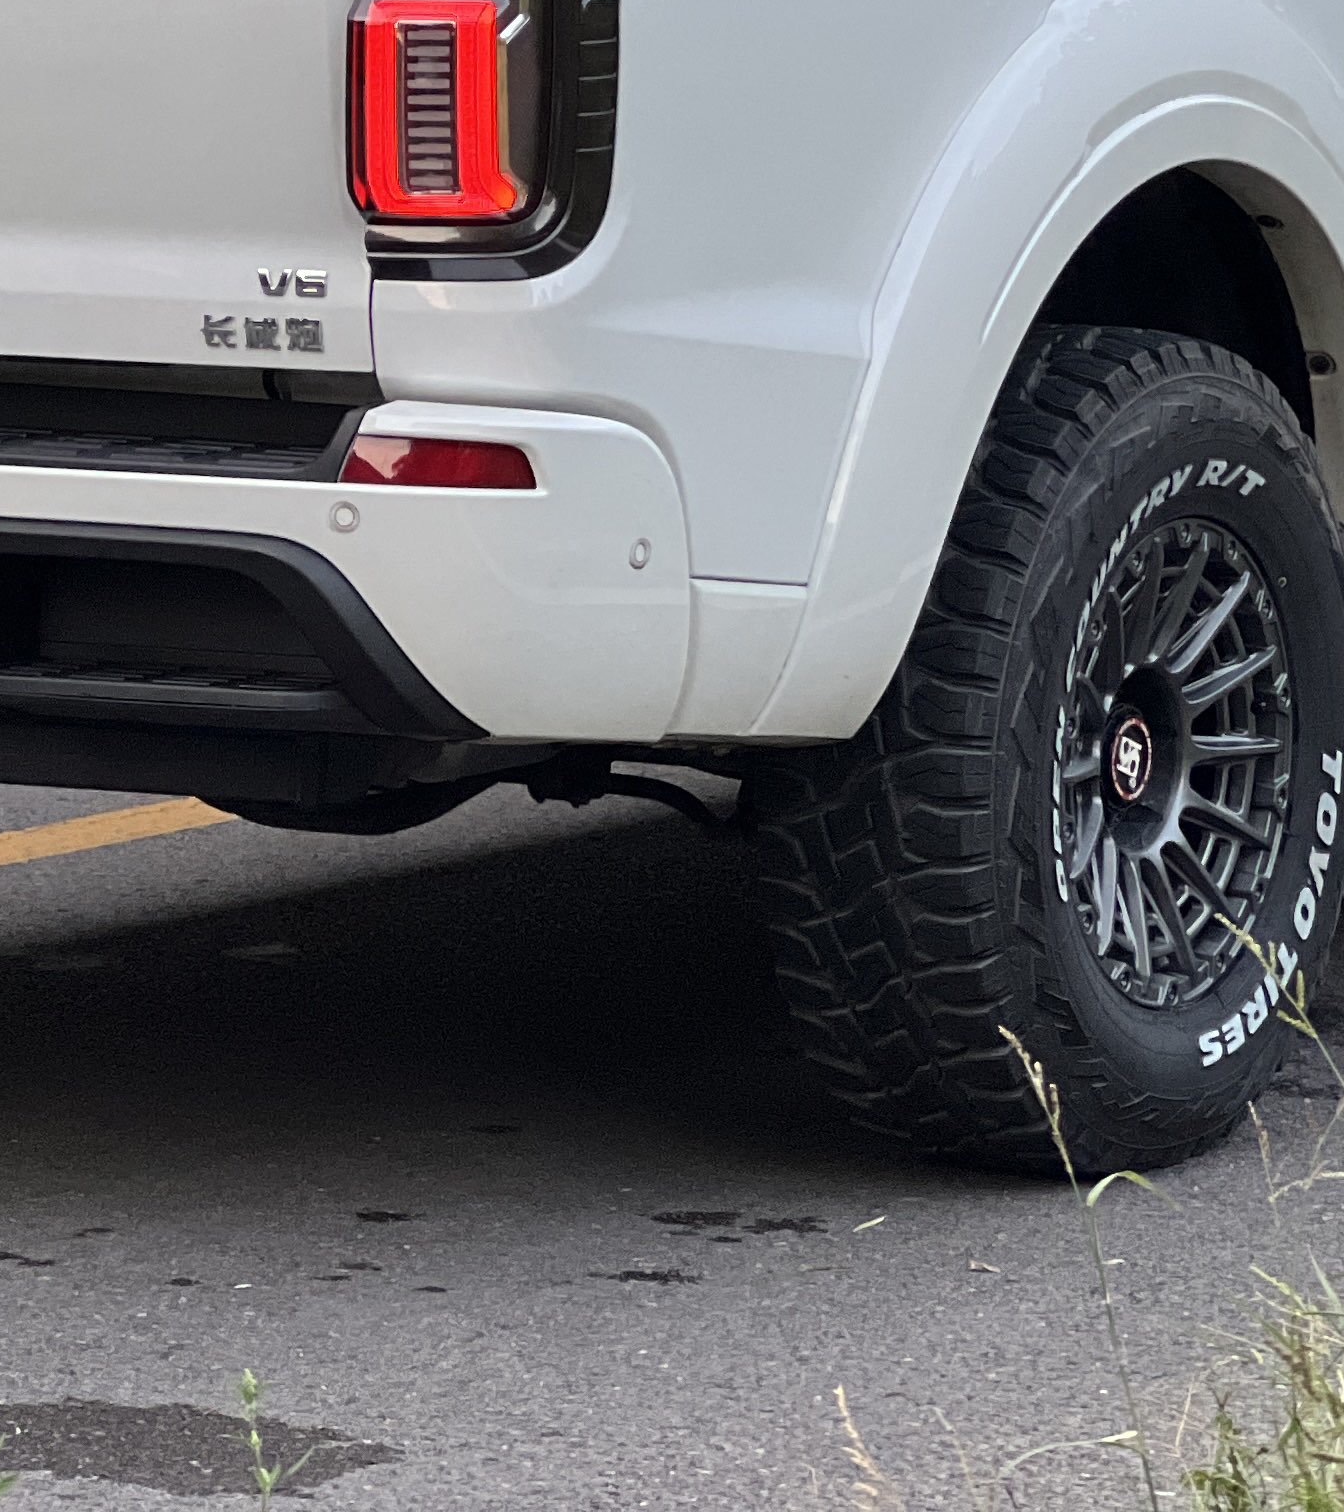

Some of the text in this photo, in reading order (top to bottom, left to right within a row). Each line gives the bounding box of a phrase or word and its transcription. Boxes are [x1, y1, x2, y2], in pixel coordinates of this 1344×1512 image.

[257, 268, 327, 298] V6
[200, 314, 324, 353] 长城炮
[1196, 457, 1267, 497] R/T
[1198, 942, 1299, 1067] TIRES
